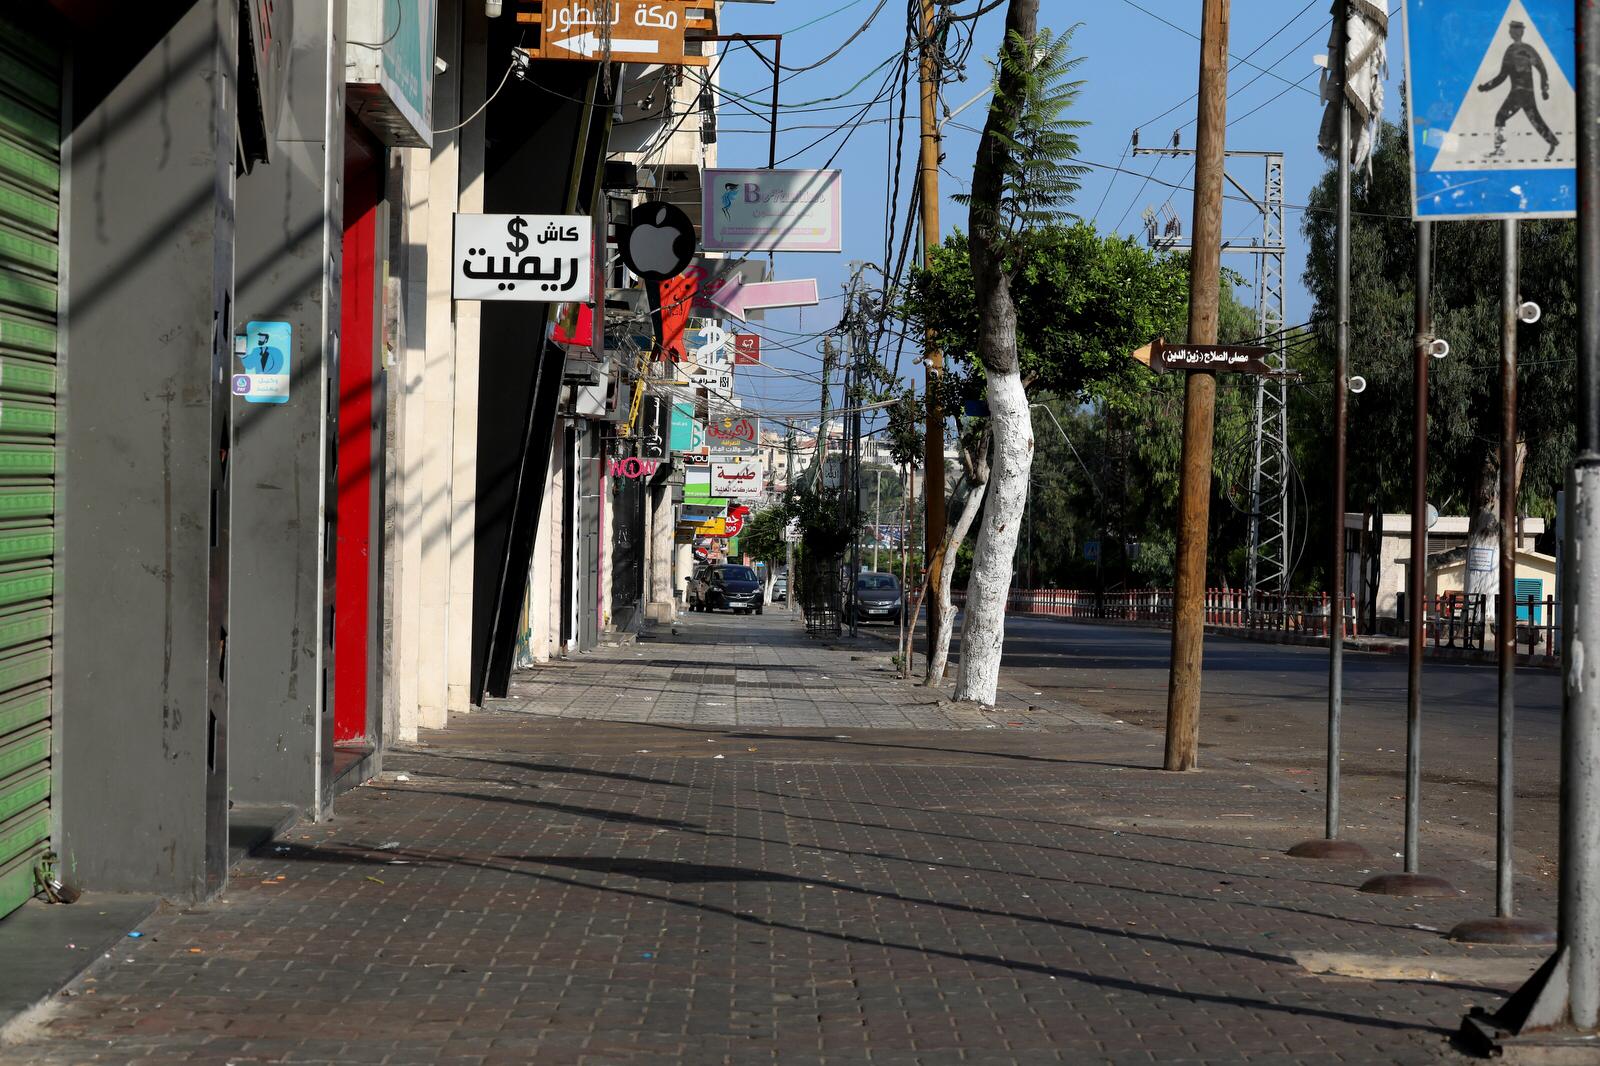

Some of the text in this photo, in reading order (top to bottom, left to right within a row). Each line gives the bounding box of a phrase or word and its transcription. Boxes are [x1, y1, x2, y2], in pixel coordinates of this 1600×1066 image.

[634, 4, 678, 30] مكة
[537, 222, 579, 244] كاش
[463, 248, 578, 292] ريميت
[1204, 351, 1228, 364] الصلاح
[1228, 352, 1249, 364] مصلى
[717, 466, 756, 484] طيبة
